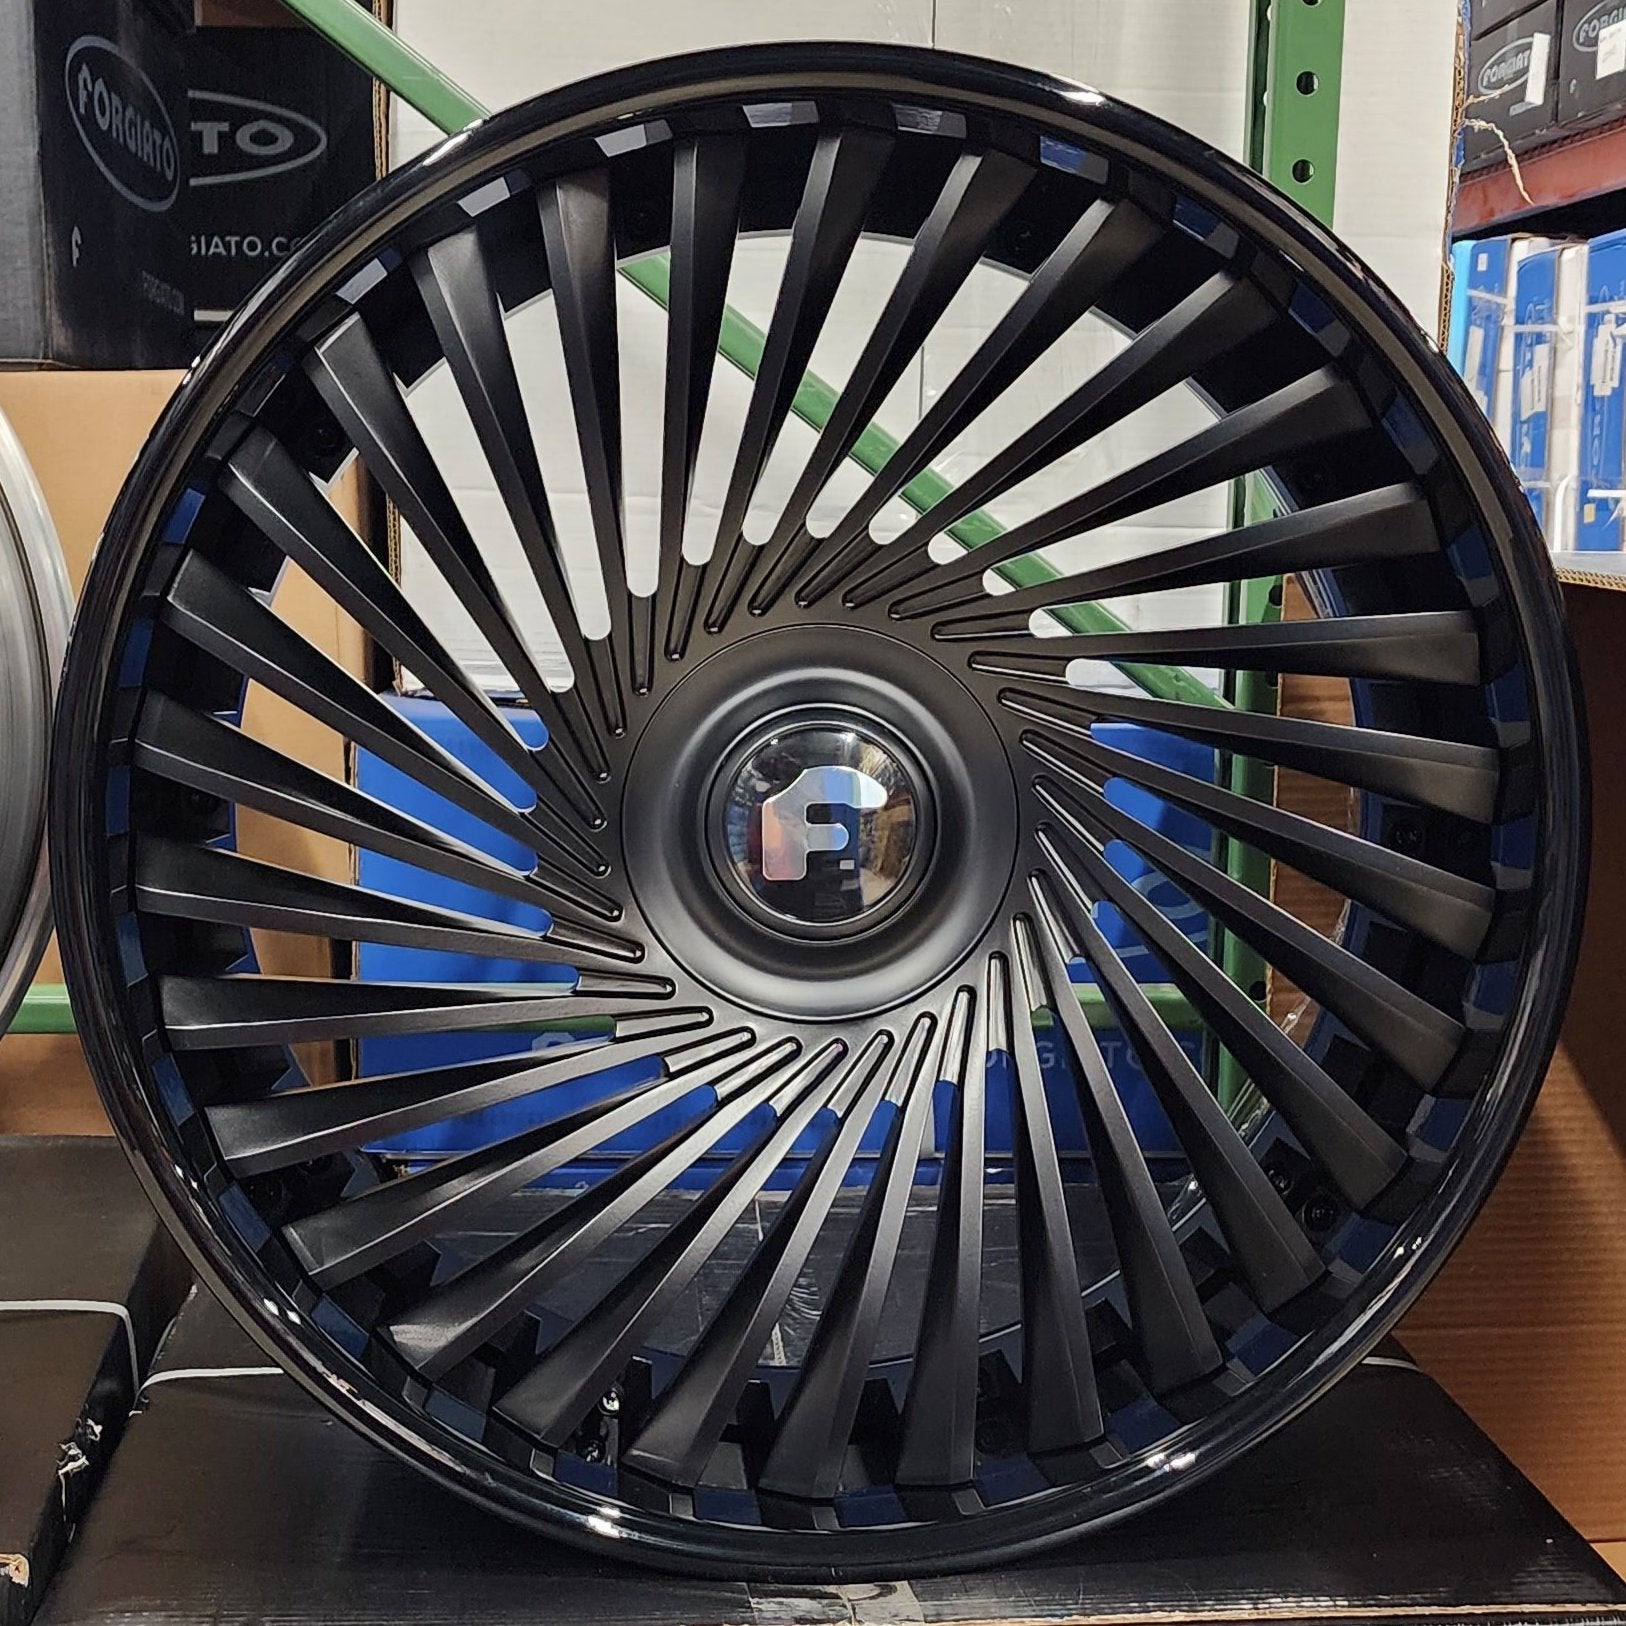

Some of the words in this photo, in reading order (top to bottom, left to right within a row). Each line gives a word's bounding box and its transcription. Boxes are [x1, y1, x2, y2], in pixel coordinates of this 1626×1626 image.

[1580, 6, 1626, 43] FORGI
[1483, 48, 1532, 86] FORGIAT
[78, 62, 174, 181] FORGIATO
